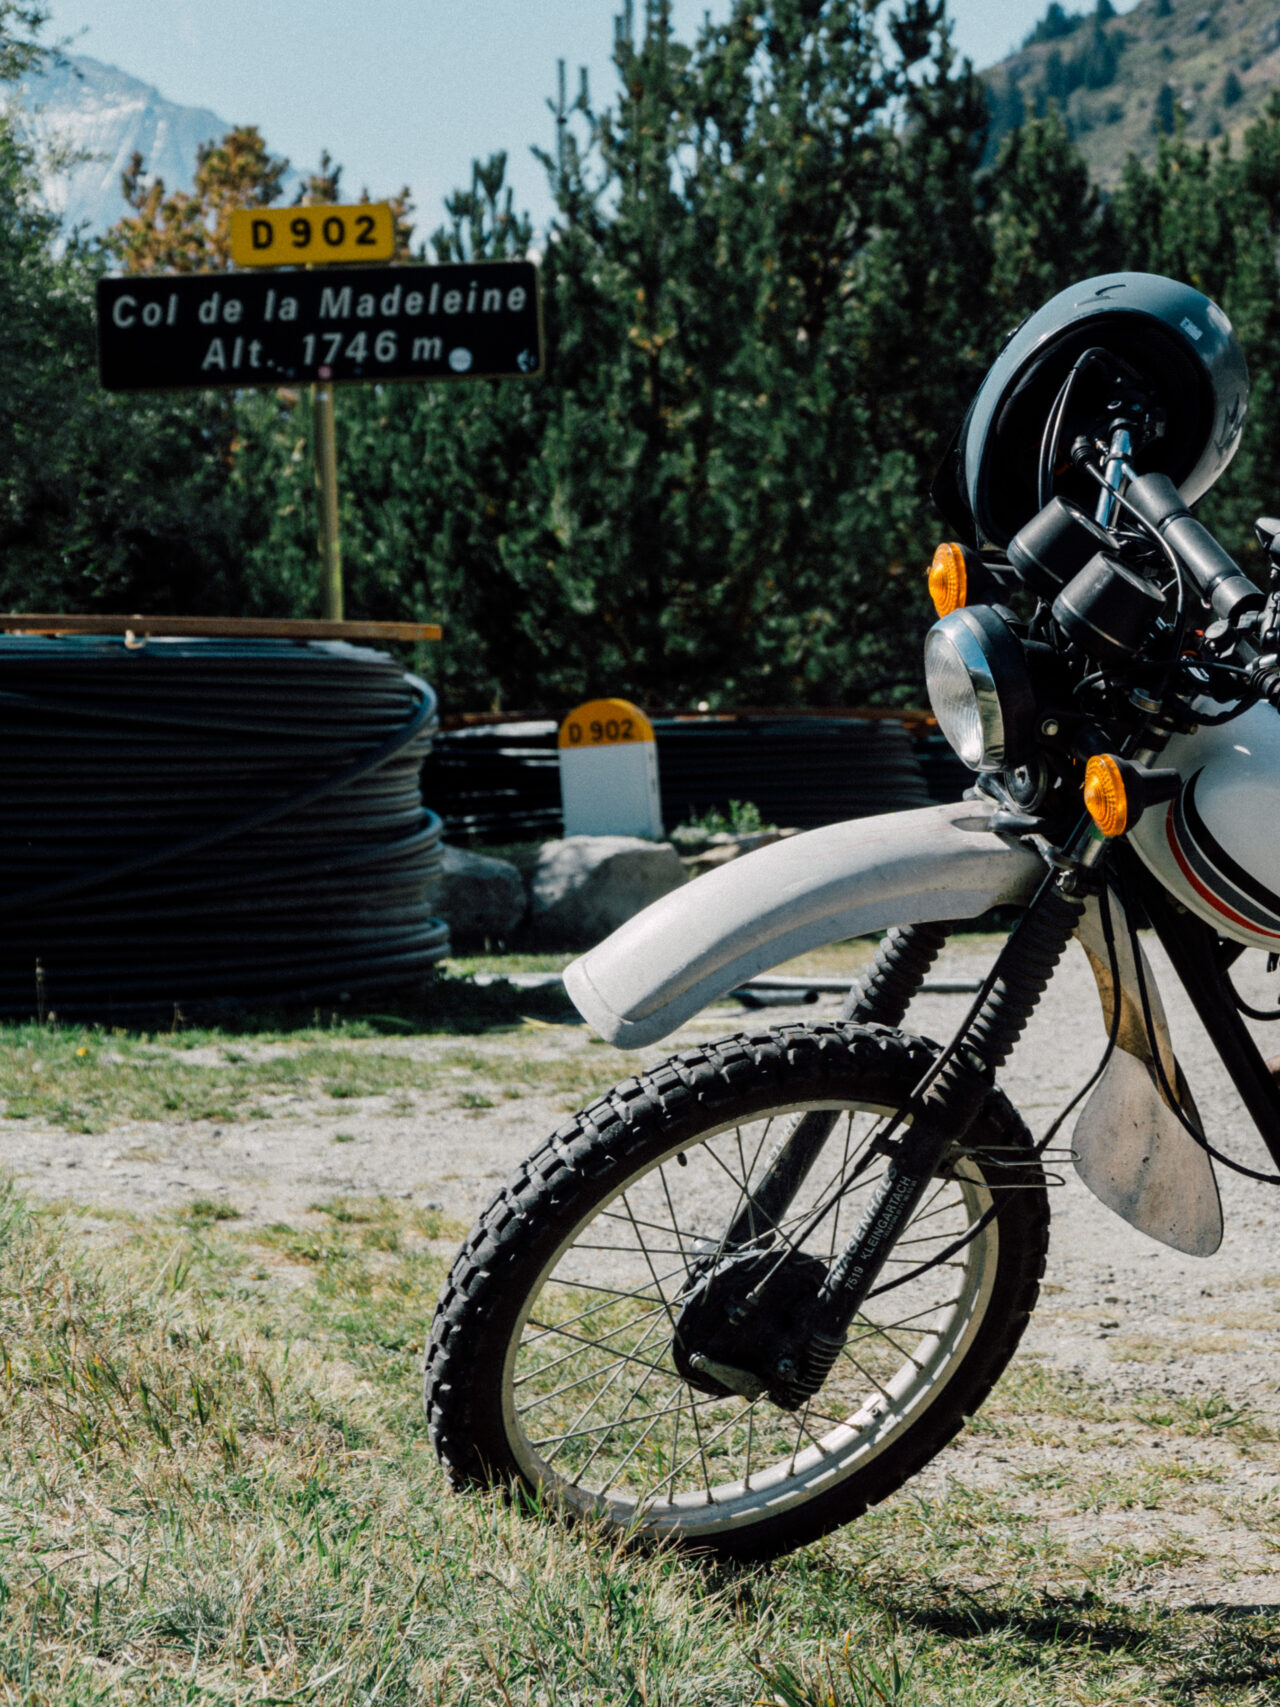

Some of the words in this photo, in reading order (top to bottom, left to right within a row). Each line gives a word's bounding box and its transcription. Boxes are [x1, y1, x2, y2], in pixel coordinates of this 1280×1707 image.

[251, 219, 273, 250] D
[290, 214, 378, 248] 902
[112, 294, 178, 328] Col
[199, 292, 243, 324] de
[264, 290, 298, 321] la
[319, 281, 526, 319] Madeleine
[202, 336, 275, 371] Alt.
[302, 331, 397, 366] 1746
[411, 337, 443, 360] m
[569, 723, 582, 743] D
[591, 719, 634, 742] 902
[844, 1266, 865, 1291] 7519
[861, 1176, 912, 1260] KLEINGARTACH
